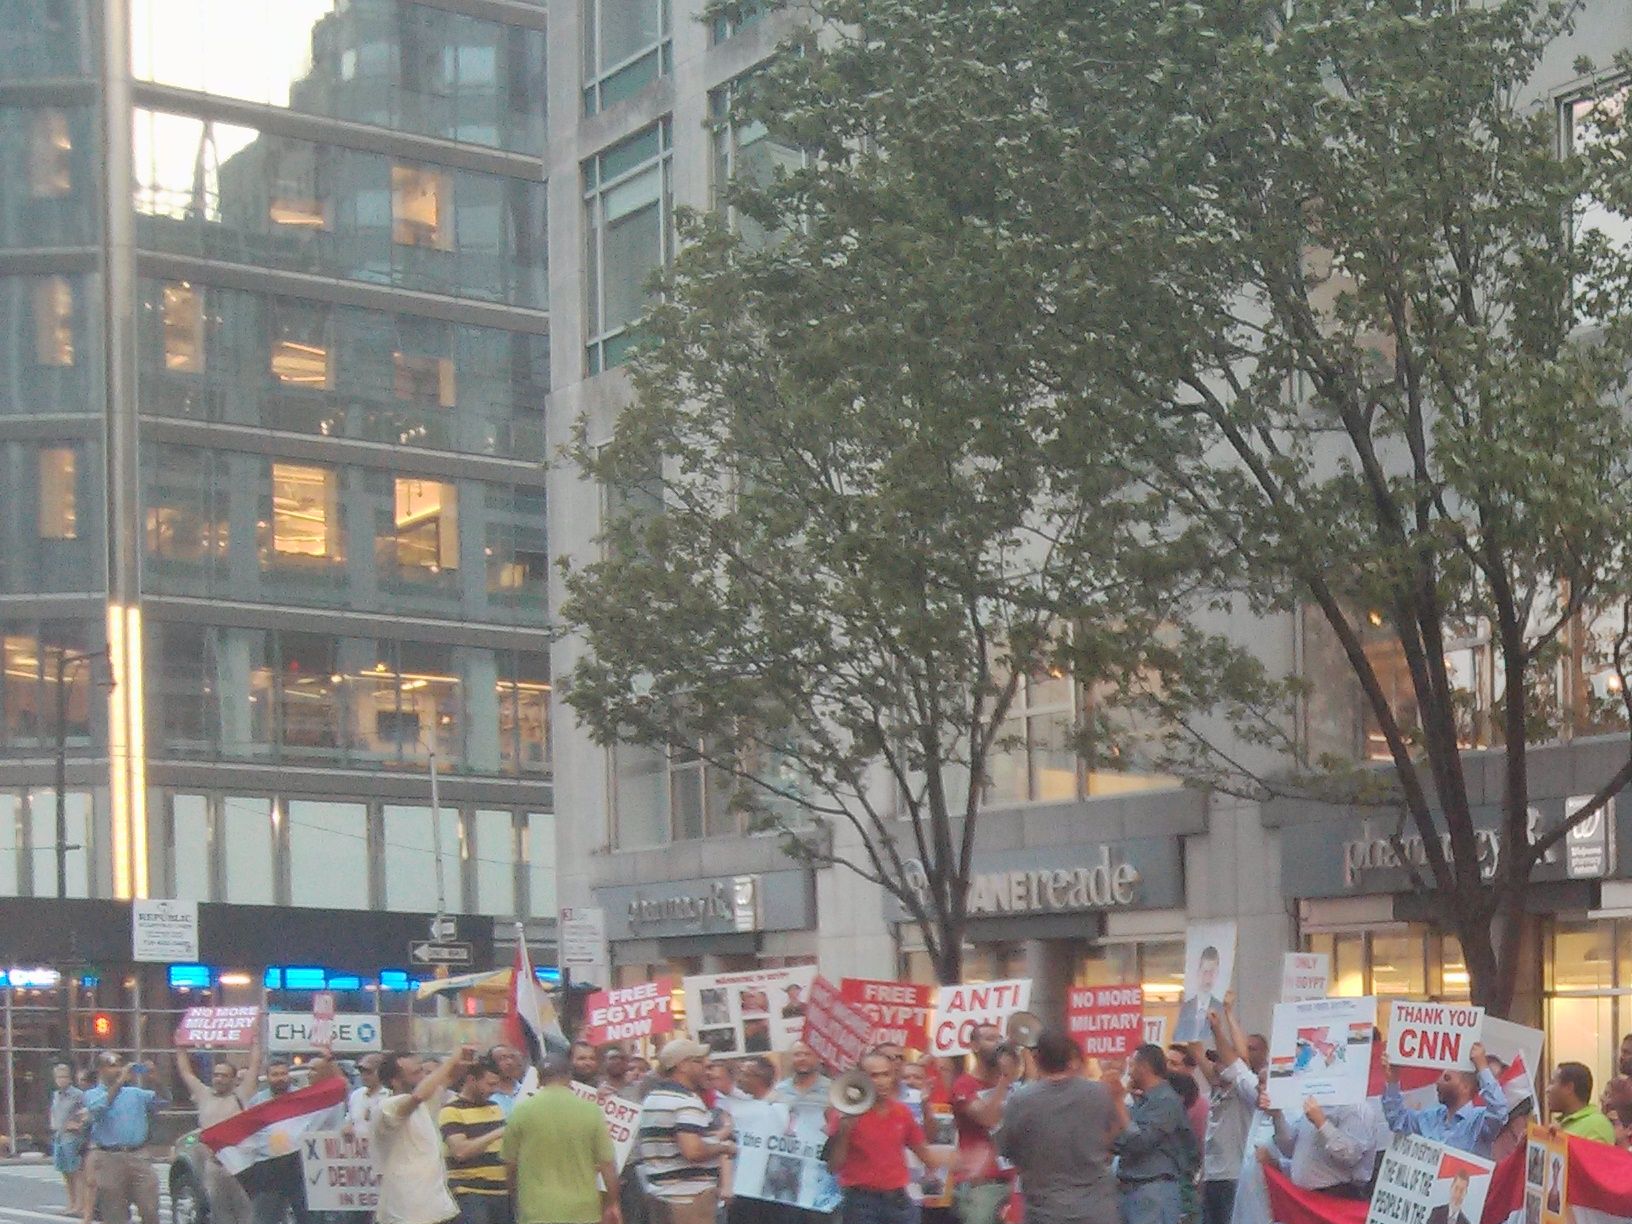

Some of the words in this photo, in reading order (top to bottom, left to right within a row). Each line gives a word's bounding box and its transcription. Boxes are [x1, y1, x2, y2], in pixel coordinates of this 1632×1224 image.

[608, 983, 659, 1004] FREE
[864, 984, 918, 1004] FREE
[946, 984, 1022, 1014] ANTI
[1072, 991, 1094, 1009] NO
[1098, 988, 1141, 1006] MORE
[191, 1006, 213, 1017] NO
[214, 1005, 259, 1017] MORE
[591, 996, 672, 1027] EGYPT
[852, 1003, 927, 1027] GYPT
[1397, 1005, 1444, 1025] THANK
[1449, 1009, 1478, 1028] YOU
[183, 1016, 257, 1029] MILITARY
[275, 1023, 352, 1040] CHE
[606, 1018, 652, 1041] NOW
[1071, 1012, 1140, 1032] MILITARY
[188, 1029, 242, 1041] RULE
[1087, 1036, 1126, 1053] RULE
[1398, 1028, 1462, 1062] CNN
[324, 1137, 369, 1159] MILITAR
[1373, 1190, 1404, 1220] PEOPLE
